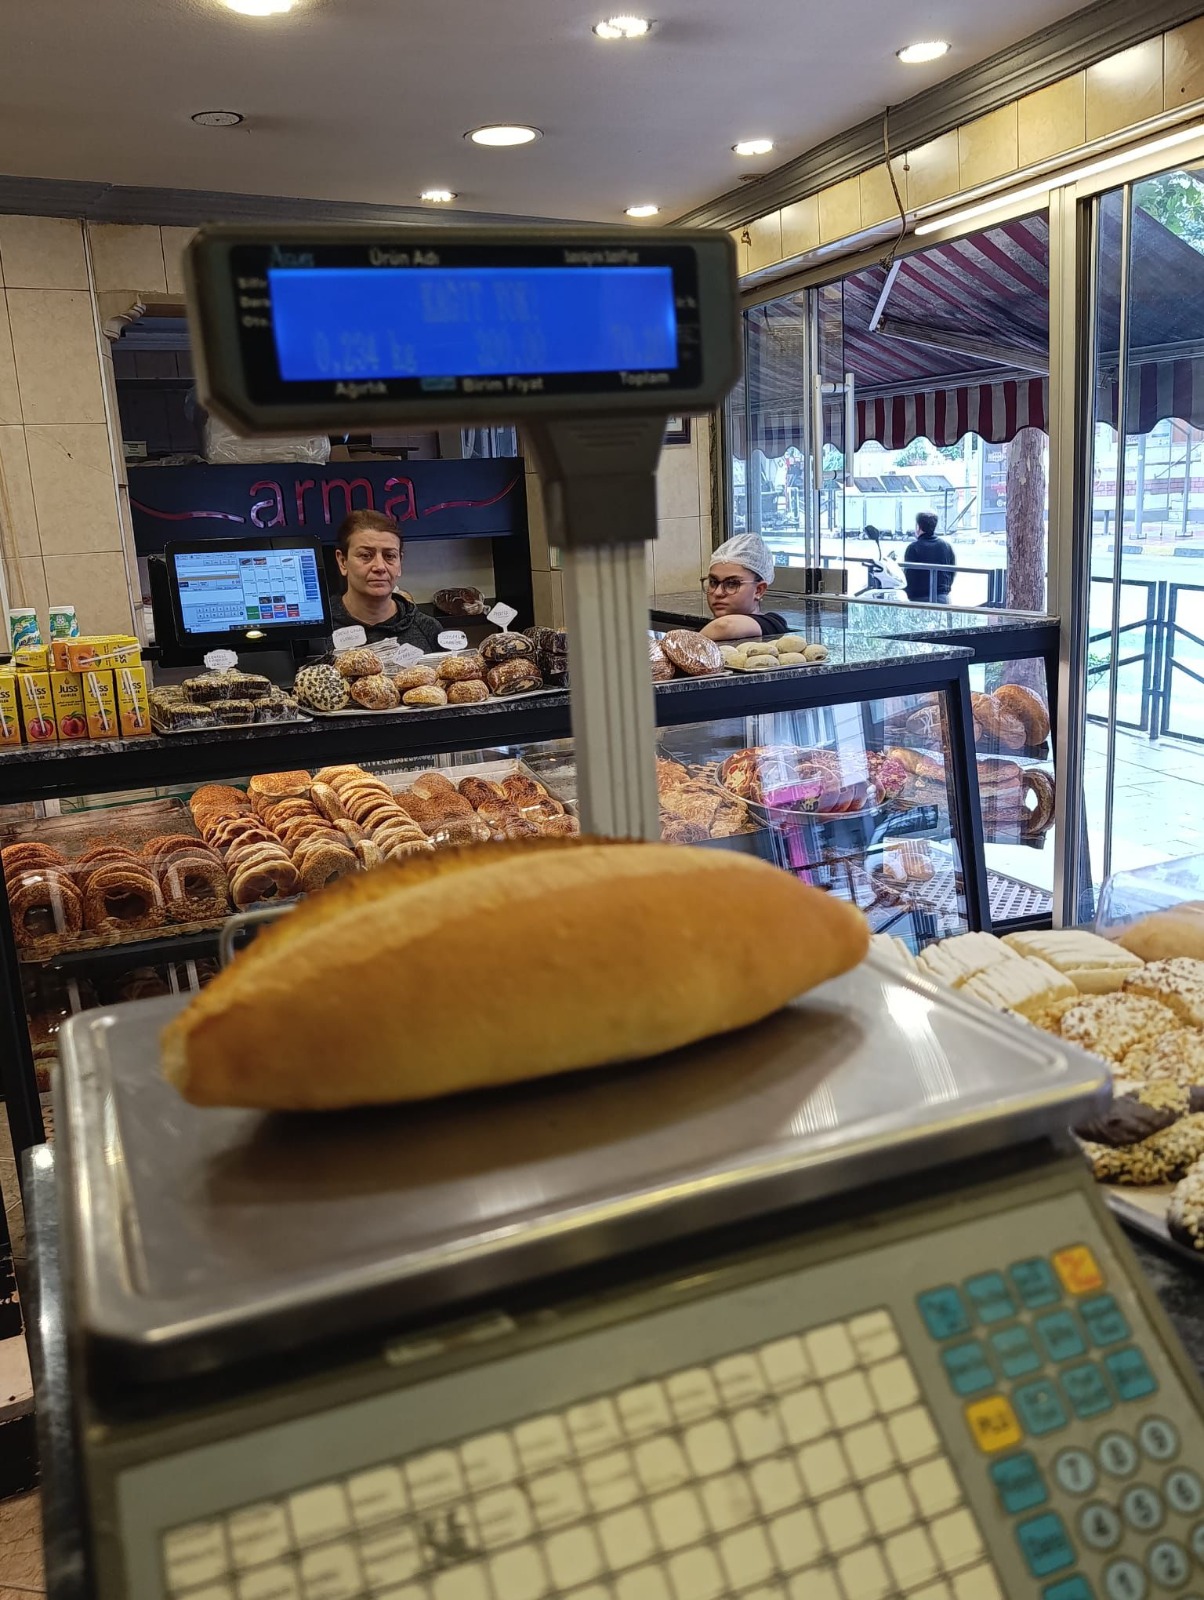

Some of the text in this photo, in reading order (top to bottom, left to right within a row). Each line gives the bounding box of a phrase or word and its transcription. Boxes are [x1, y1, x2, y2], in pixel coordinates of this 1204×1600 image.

[369, 247, 410, 266] Ürün
[506, 376, 544, 393] Fiyat
[619, 371, 669, 386] Toplam
[249, 477, 417, 528] arma
[58, 685, 78, 694] Juss
[1064, 1455, 1082, 1483] 7
[1133, 1494, 1153, 1523] 5
[1093, 1511, 1111, 1538] 4
[1159, 1551, 1179, 1580] 2
